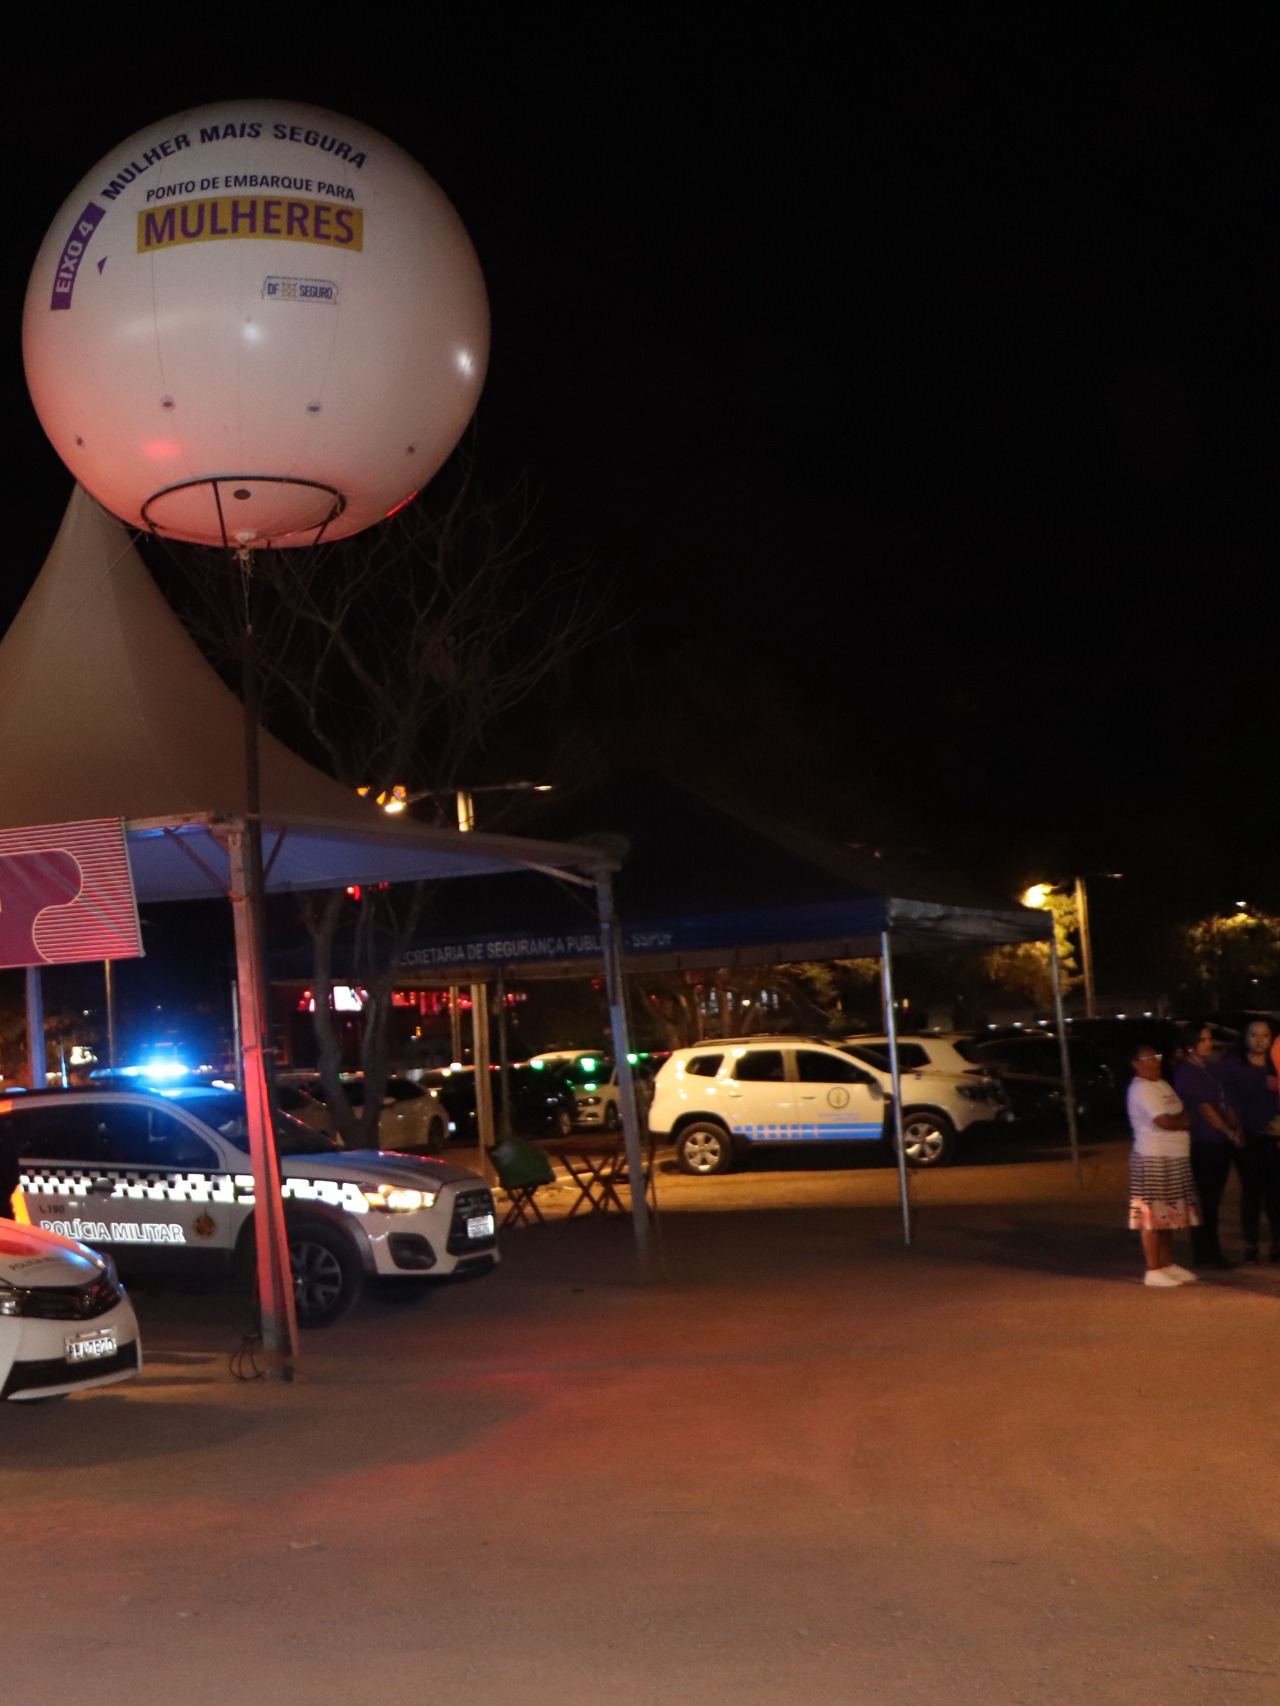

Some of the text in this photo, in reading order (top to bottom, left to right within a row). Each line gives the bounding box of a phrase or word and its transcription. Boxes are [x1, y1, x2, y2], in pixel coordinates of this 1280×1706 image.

[100, 122, 368, 201] MULHER MAIS SEGURA
[146, 175, 356, 202] PONTO DE EMBARQUE PARA
[144, 200, 355, 246] MULHERES
[55, 219, 94, 294] EIXO 4
[267, 283, 333, 299] DF SEGURO
[396, 944, 465, 966] CRETARIA
[466, 943, 484, 960] DE
[486, 936, 566, 959] SEGURANÇA
[41, 1218, 186, 1244] POLÍCIA MILITAR
